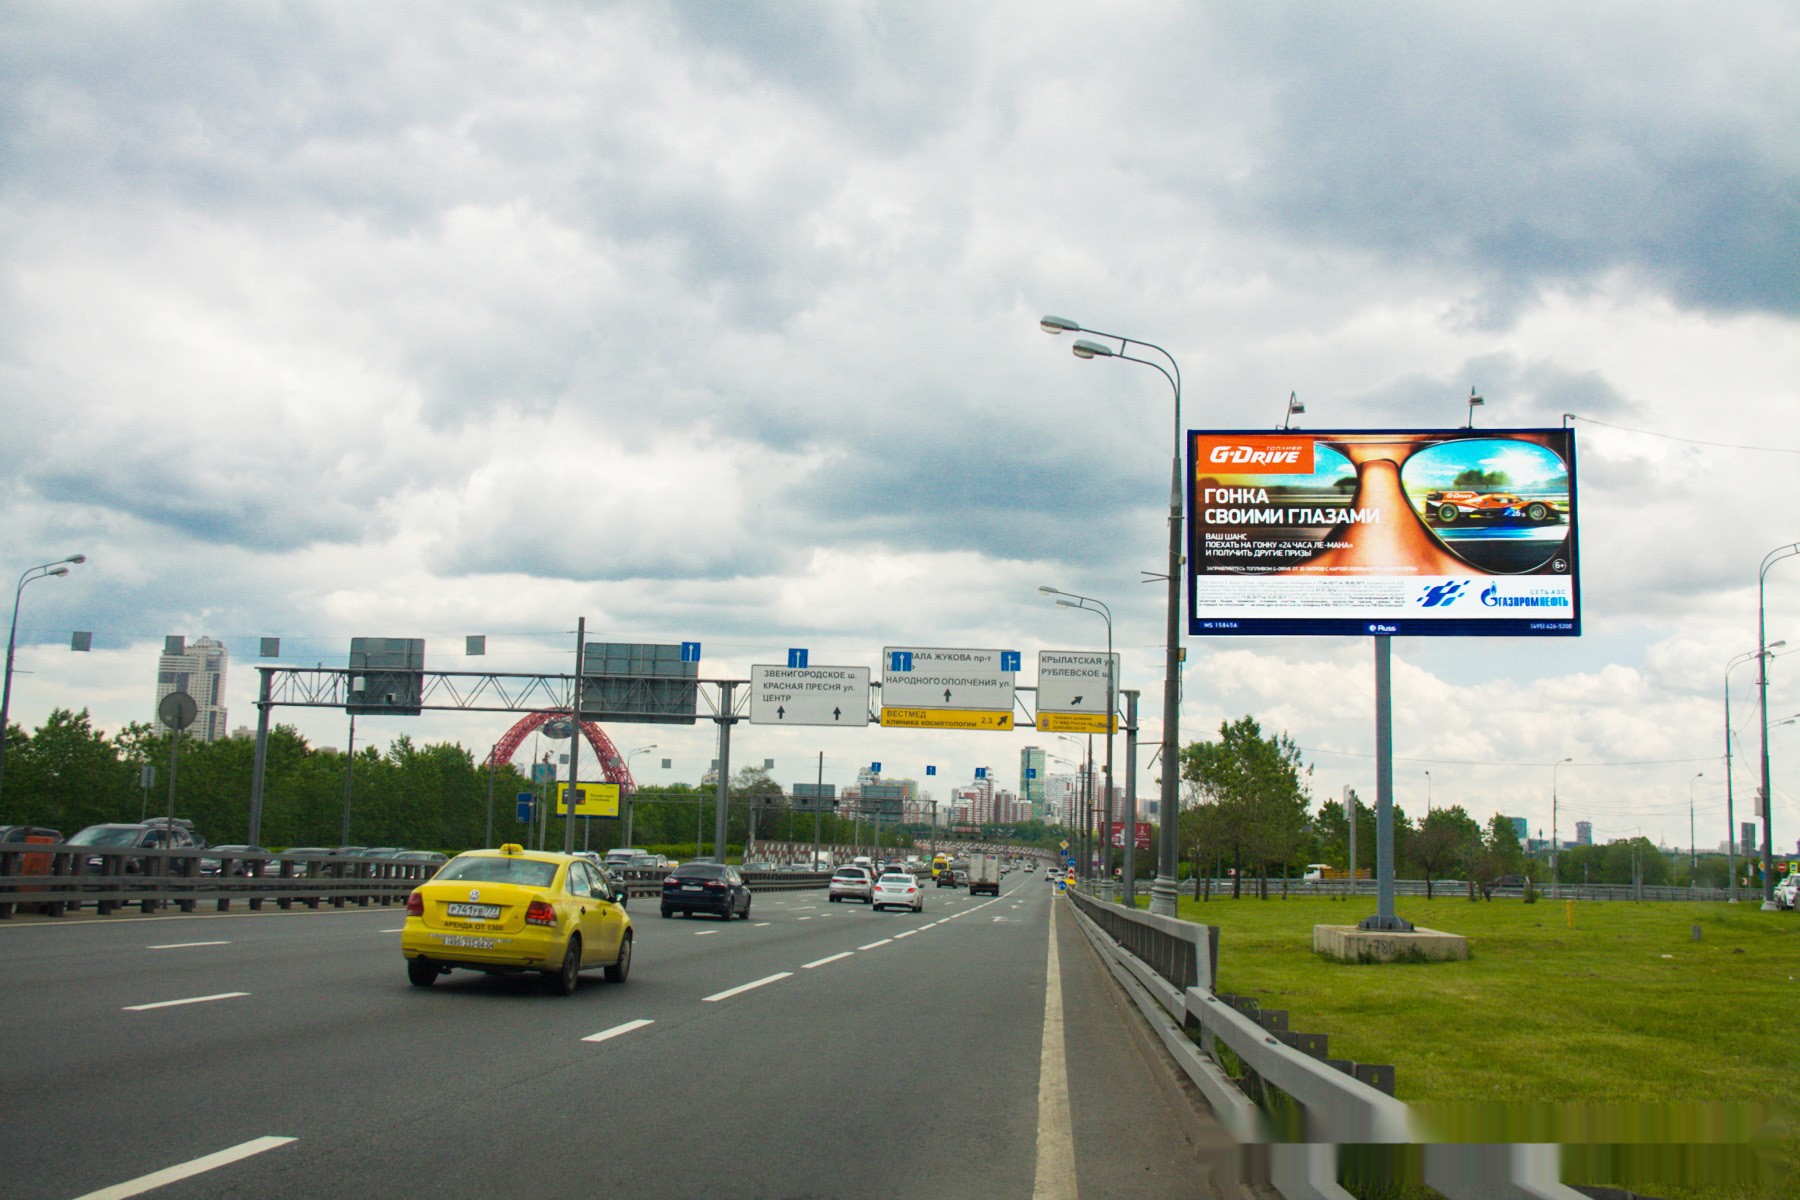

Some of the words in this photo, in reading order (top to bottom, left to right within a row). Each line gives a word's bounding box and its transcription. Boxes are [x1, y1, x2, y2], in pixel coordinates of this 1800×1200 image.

[1204, 488, 1270, 504] ГОНКА
[1204, 508, 1284, 524] СВОИМИ
[1288, 508, 1380, 524] ГЛАЗАМИ
[1499, 597, 1568, 607] ГАЗПРОМНЕФТЬ
[935, 653, 971, 661] ЖУКОВА
[1042, 656, 1102, 664] КРЫЛАТСКАЯ
[764, 670, 845, 679] ЗВЕНИГОРОДСКОЕ
[1042, 669, 1099, 677] РУБЛЕВСКОЕ
[886, 676, 940, 685] НАРОДНОГО
[941, 678, 996, 686] ОПОЛЧЕНИЯ
[805, 683, 841, 691] ПРЕСНЯ
[887, 710, 926, 719] ВЕСТМЕД
[444, 921, 473, 929] АРЕНДА
